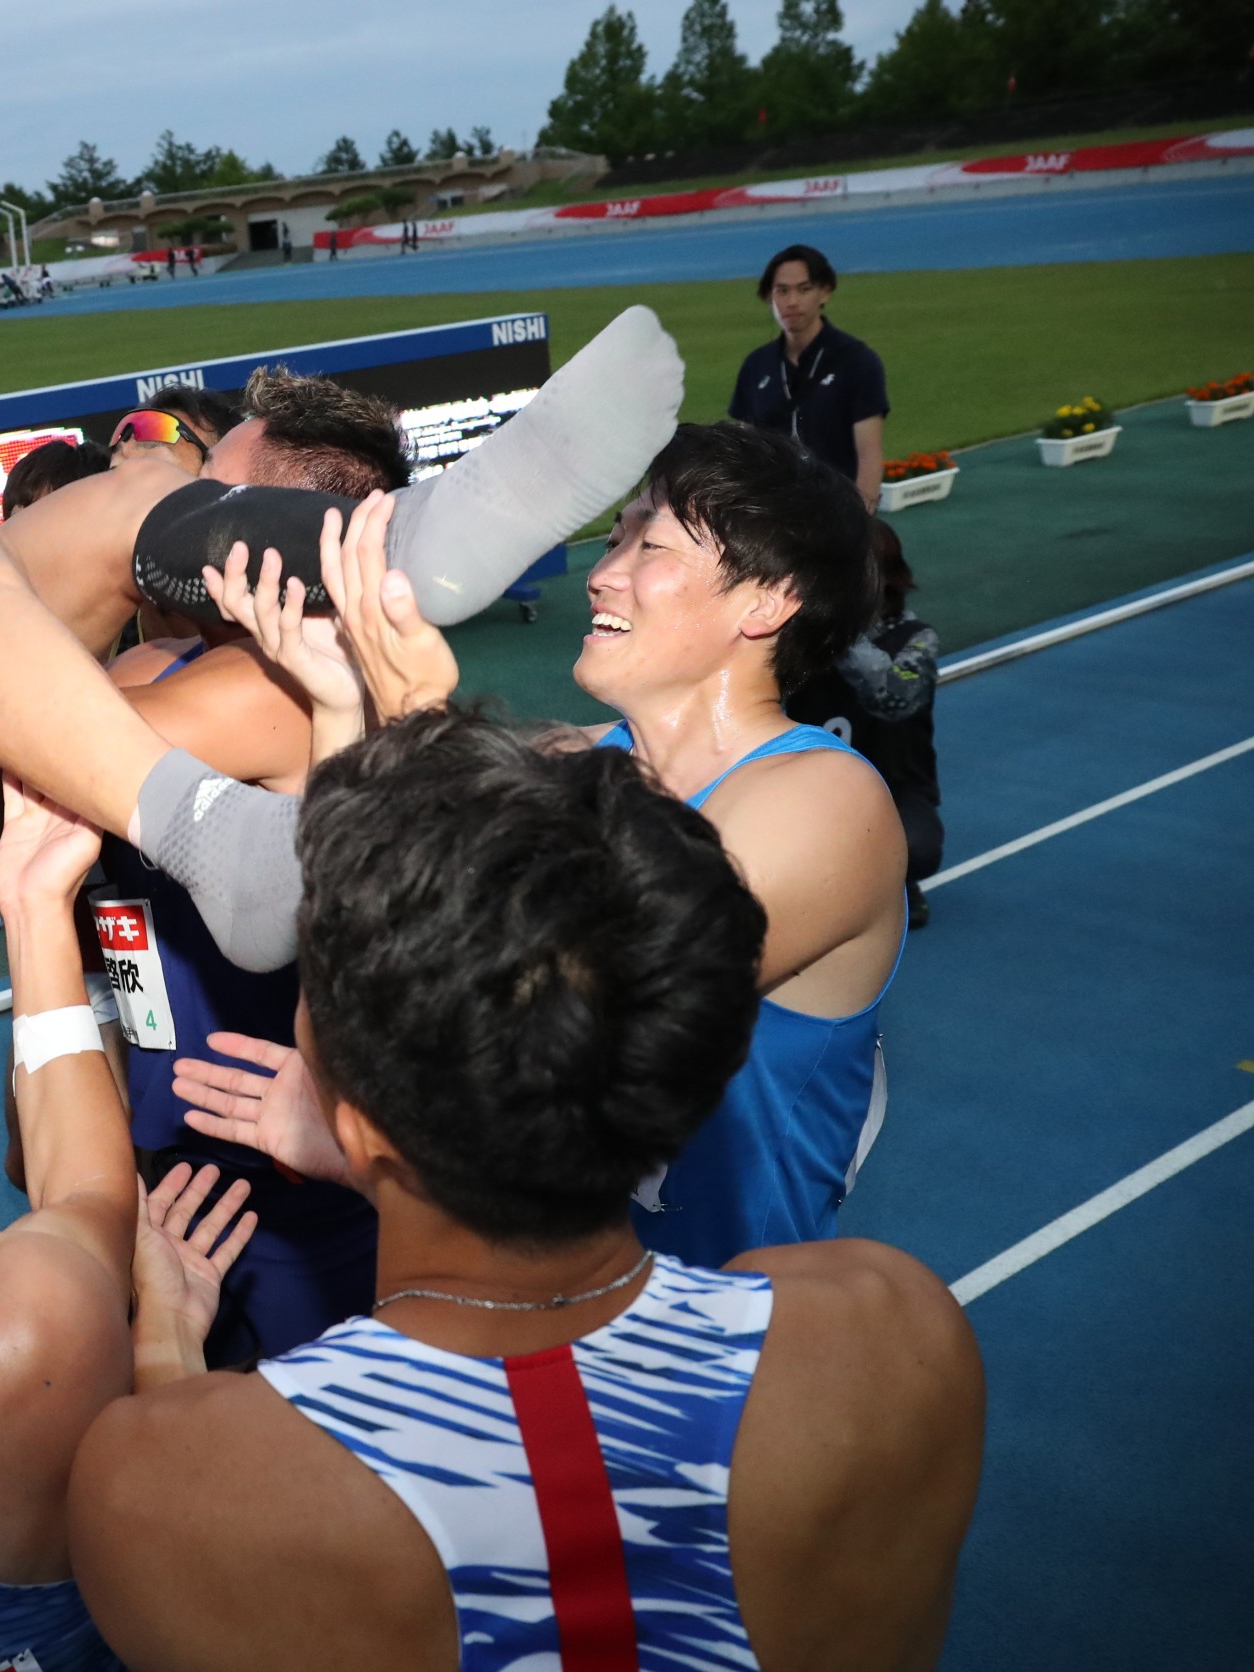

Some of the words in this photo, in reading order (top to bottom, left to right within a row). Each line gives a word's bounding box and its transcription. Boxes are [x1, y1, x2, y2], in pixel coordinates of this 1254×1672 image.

[1026, 152, 1072, 173] JAAF
[804, 179, 844, 197] JAAF
[605, 200, 642, 219] JAAF
[491, 316, 547, 346] NISHI
[146, 1009, 158, 1031] 4
